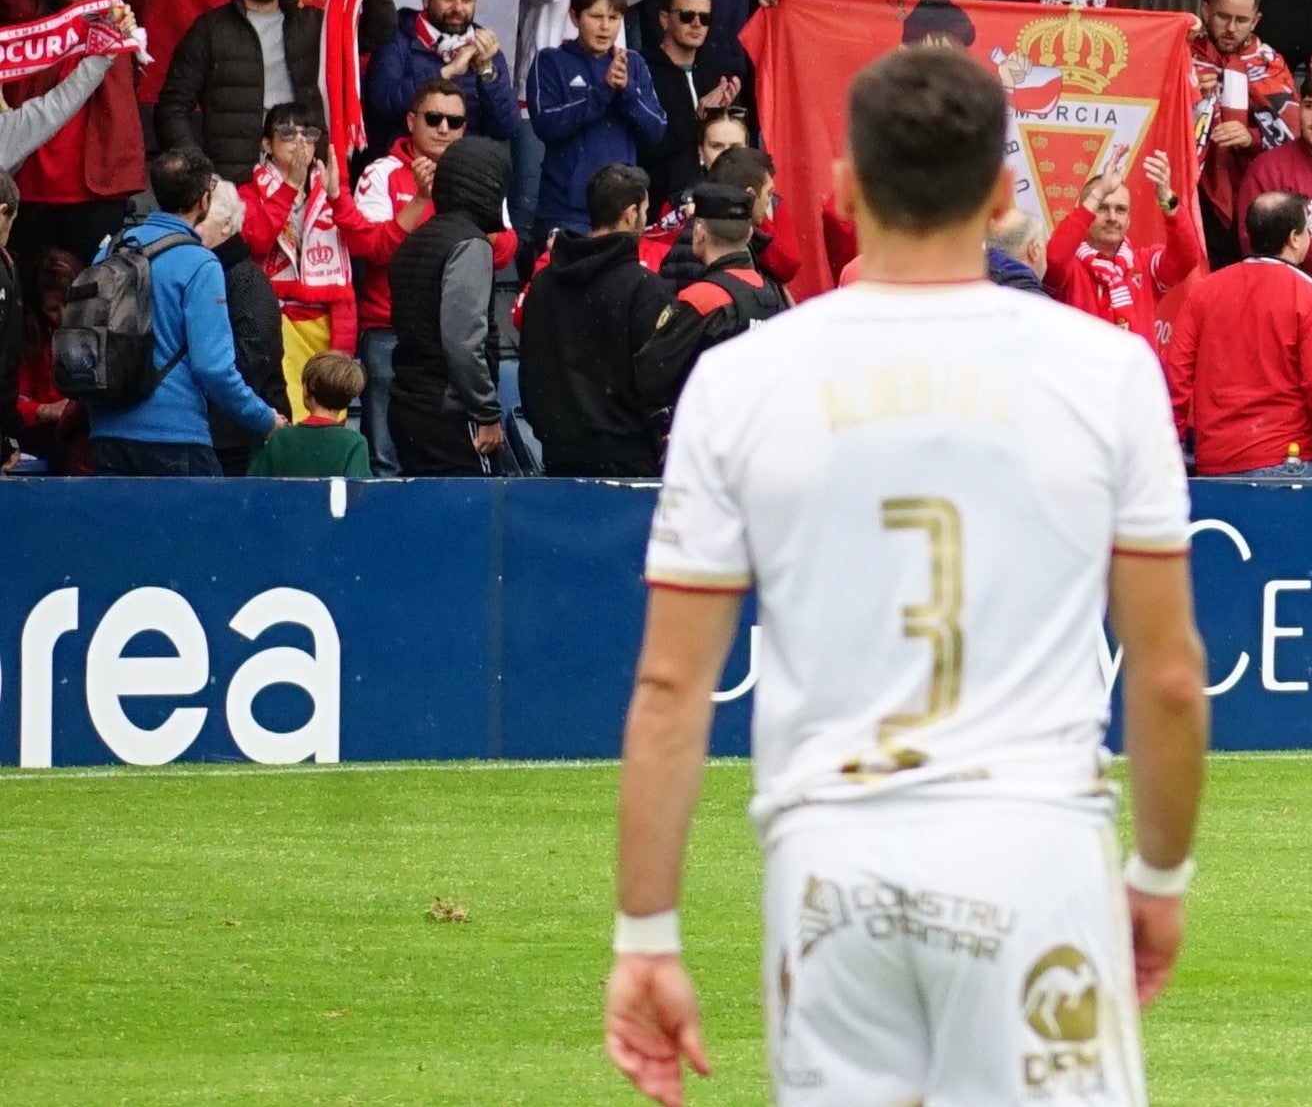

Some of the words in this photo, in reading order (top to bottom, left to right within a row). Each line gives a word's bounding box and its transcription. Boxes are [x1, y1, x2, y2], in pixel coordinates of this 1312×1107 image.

[0, 26, 80, 64] CURA
[0, 586, 341, 769] rea
[878, 496, 967, 770] 3
